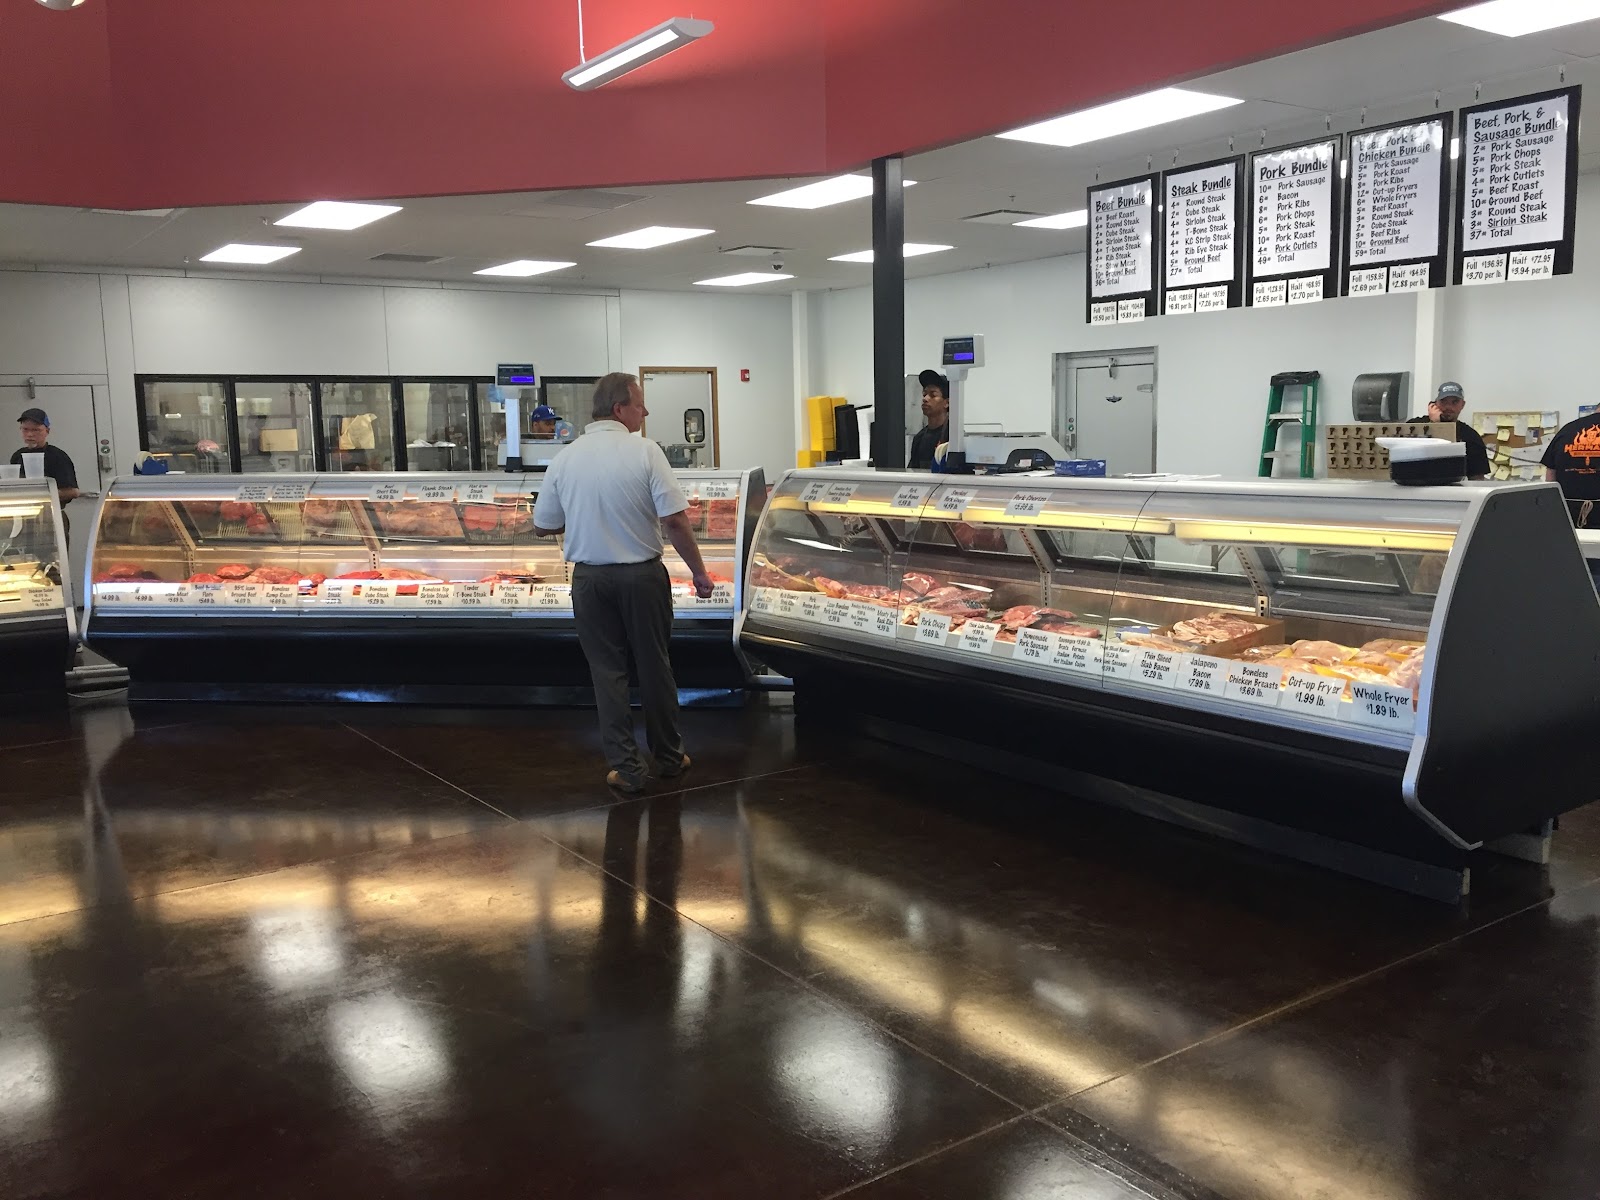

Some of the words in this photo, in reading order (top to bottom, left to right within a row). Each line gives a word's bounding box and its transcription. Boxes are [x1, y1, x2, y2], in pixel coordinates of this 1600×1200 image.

[1474, 114, 1500, 129] Beef,
[1504, 110, 1531, 124] Pork,
[1536, 106, 1545, 118] &
[1473, 127, 1521, 144] Sausage
[1524, 117, 1560, 134] Bundle
[1491, 140, 1511, 151] Pork
[1515, 134, 1553, 147] Sausage
[1358, 149, 1396, 162] Chicken
[1399, 143, 1430, 156] Bundle
[1490, 151, 1510, 162] Pork
[1514, 148, 1540, 158] Chops
[1260, 164, 1286, 179] Pork
[1291, 158, 1327, 174] Bundle
[1374, 160, 1389, 169] Pork
[1391, 157, 1418, 166] Sausage
[1490, 162, 1510, 173] Pork
[1513, 157, 1541, 169] Steak
[1373, 169, 1388, 178] Pork
[1390, 166, 1410, 175] Roast
[1489, 173, 1509, 184] Pork
[1513, 169, 1544, 180] Cutlets
[1171, 182, 1197, 196] Steak
[1202, 175, 1231, 191] Bundle
[1278, 180, 1293, 190] Pork
[1296, 176, 1325, 187] Sausage
[1373, 178, 1388, 186] Pork
[1489, 183, 1508, 195] Beef
[1511, 180, 1539, 191] Roast
[1372, 186, 1395, 195] Cut-up
[1396, 183, 1417, 191] Fryers
[1186, 196, 1204, 206] Round
[1207, 192, 1225, 203] Steak
[1277, 192, 1298, 200] Bacon
[1372, 194, 1394, 203] Whole
[1395, 192, 1416, 200] Fryers
[1488, 193, 1519, 205] Ground
[1523, 189, 1543, 201] Beef
[1095, 198, 1114, 212] Beef
[1185, 208, 1199, 216] Cube
[1201, 203, 1219, 213] Steak
[1277, 201, 1292, 210] Pork
[1295, 199, 1309, 208] Ribs
[1372, 204, 1386, 212] Beef
[1388, 201, 1407, 210] Roast
[1488, 204, 1515, 216] Round
[1519, 200, 1546, 212] Steak
[1185, 216, 1205, 226] Sirloin
[1207, 212, 1225, 222] Steak
[1276, 212, 1291, 221] Pork
[1294, 210, 1314, 218] Chops
[1371, 211, 1392, 220] Round
[1393, 208, 1413, 217] Steak
[1487, 216, 1516, 227] Sirloin
[1520, 211, 1547, 223] Steak
[1185, 226, 1207, 235] T-Bone
[1209, 222, 1227, 232] Steak
[1276, 222, 1291, 231] Pork
[1294, 219, 1315, 229] Steak
[1388, 218, 1407, 227] Steak
[1275, 232, 1291, 241] Pork
[1293, 230, 1315, 239] Roast
[1370, 229, 1384, 237] Beef
[1490, 226, 1512, 237] Total
[1195, 235, 1210, 244] Strip
[1212, 232, 1231, 241] Steak
[1369, 236, 1393, 246] Ground
[1395, 234, 1409, 243] Beef
[1196, 245, 1206, 254] Eye
[1209, 242, 1228, 251] Steak
[1275, 243, 1290, 252] Pork
[1293, 240, 1317, 250] Cutlets
[1369, 246, 1386, 255] Total
[1184, 255, 1204, 264] Ground
[1207, 252, 1220, 261] Beef
[1277, 252, 1294, 262] Total
[1532, 255, 1551, 263] $72.95
[1187, 264, 1202, 273] Total
[1030, 641, 1049, 651] Sausage
[1157, 653, 1172, 663] Sliced
[1141, 660, 1152, 669] Slab
[1154, 662, 1170, 672] Bacon
[1193, 669, 1211, 678] Bacon
[1242, 667, 1268, 678] Boneless
[1188, 679, 1203, 688] $7.99
[1228, 675, 1252, 686] Chicken
[1254, 679, 1279, 690] Breasts
[1288, 676, 1315, 690] Cut-up
[1317, 681, 1341, 694] Fryer
[1295, 692, 1314, 704] $1.99
[1316, 696, 1325, 706] lb.
[1353, 687, 1382, 701] Whole
[1385, 692, 1410, 706] Fryer
[1366, 703, 1386, 716] $1.89
[1389, 707, 1399, 718] lb.
